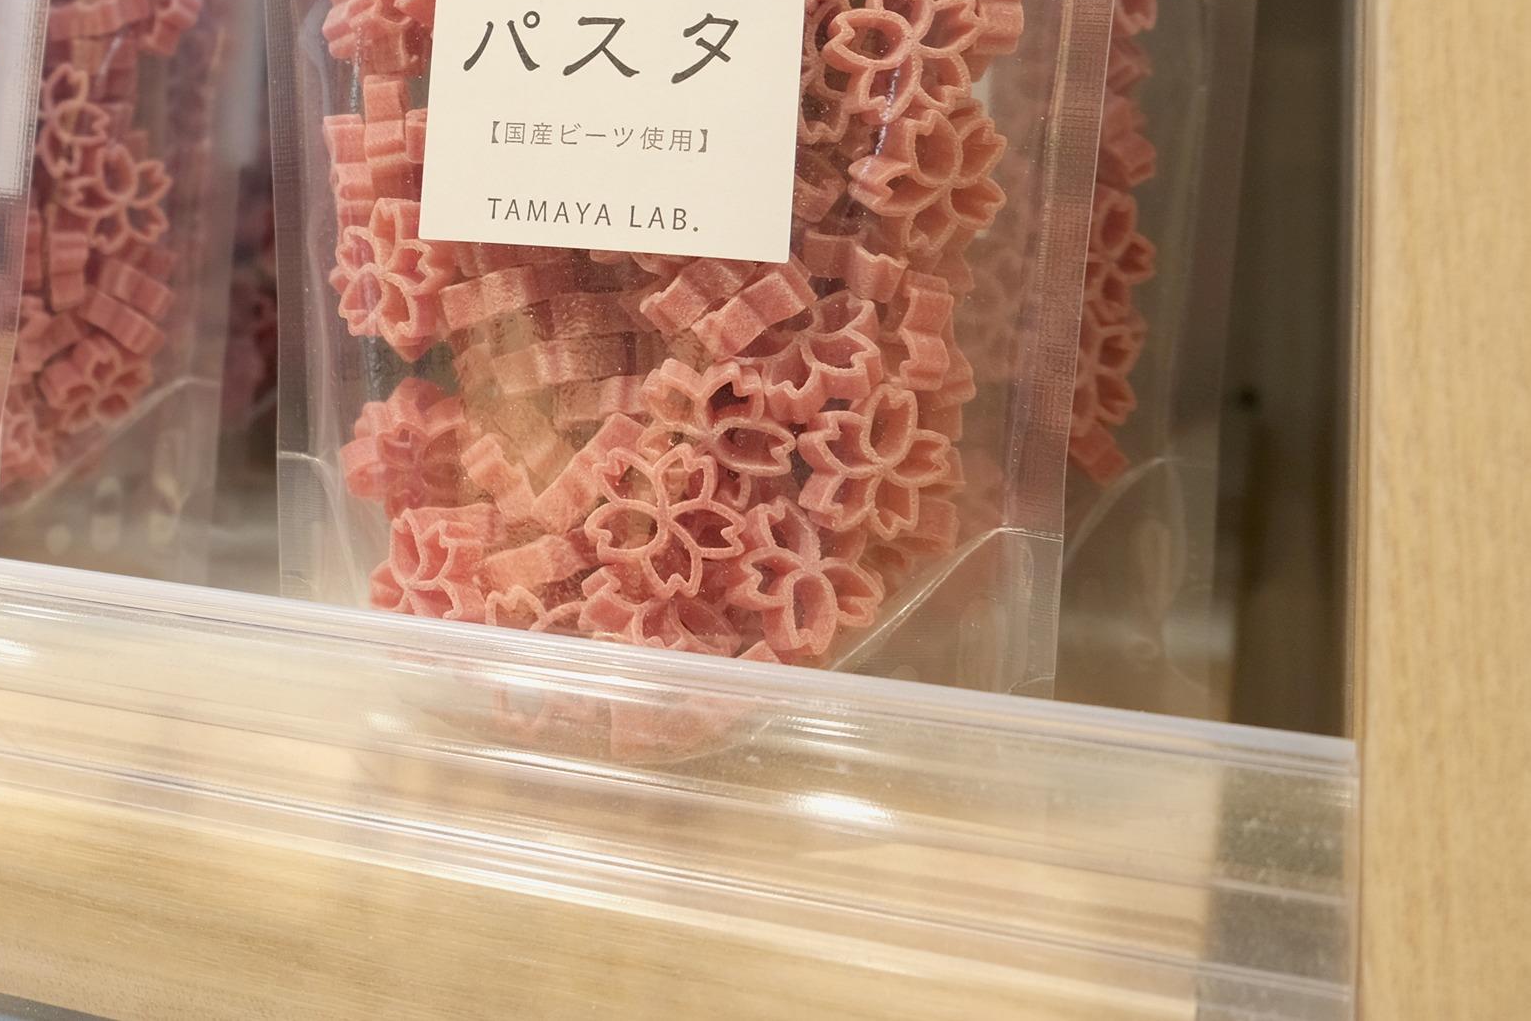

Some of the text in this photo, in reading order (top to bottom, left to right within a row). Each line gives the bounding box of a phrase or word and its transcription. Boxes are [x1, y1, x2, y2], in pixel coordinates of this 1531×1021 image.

[462, 10, 740, 85] パスタ
[490, 119, 710, 154] 【国産ビーツ使用】
[487, 197, 700, 233] TAMAYA LAB.
